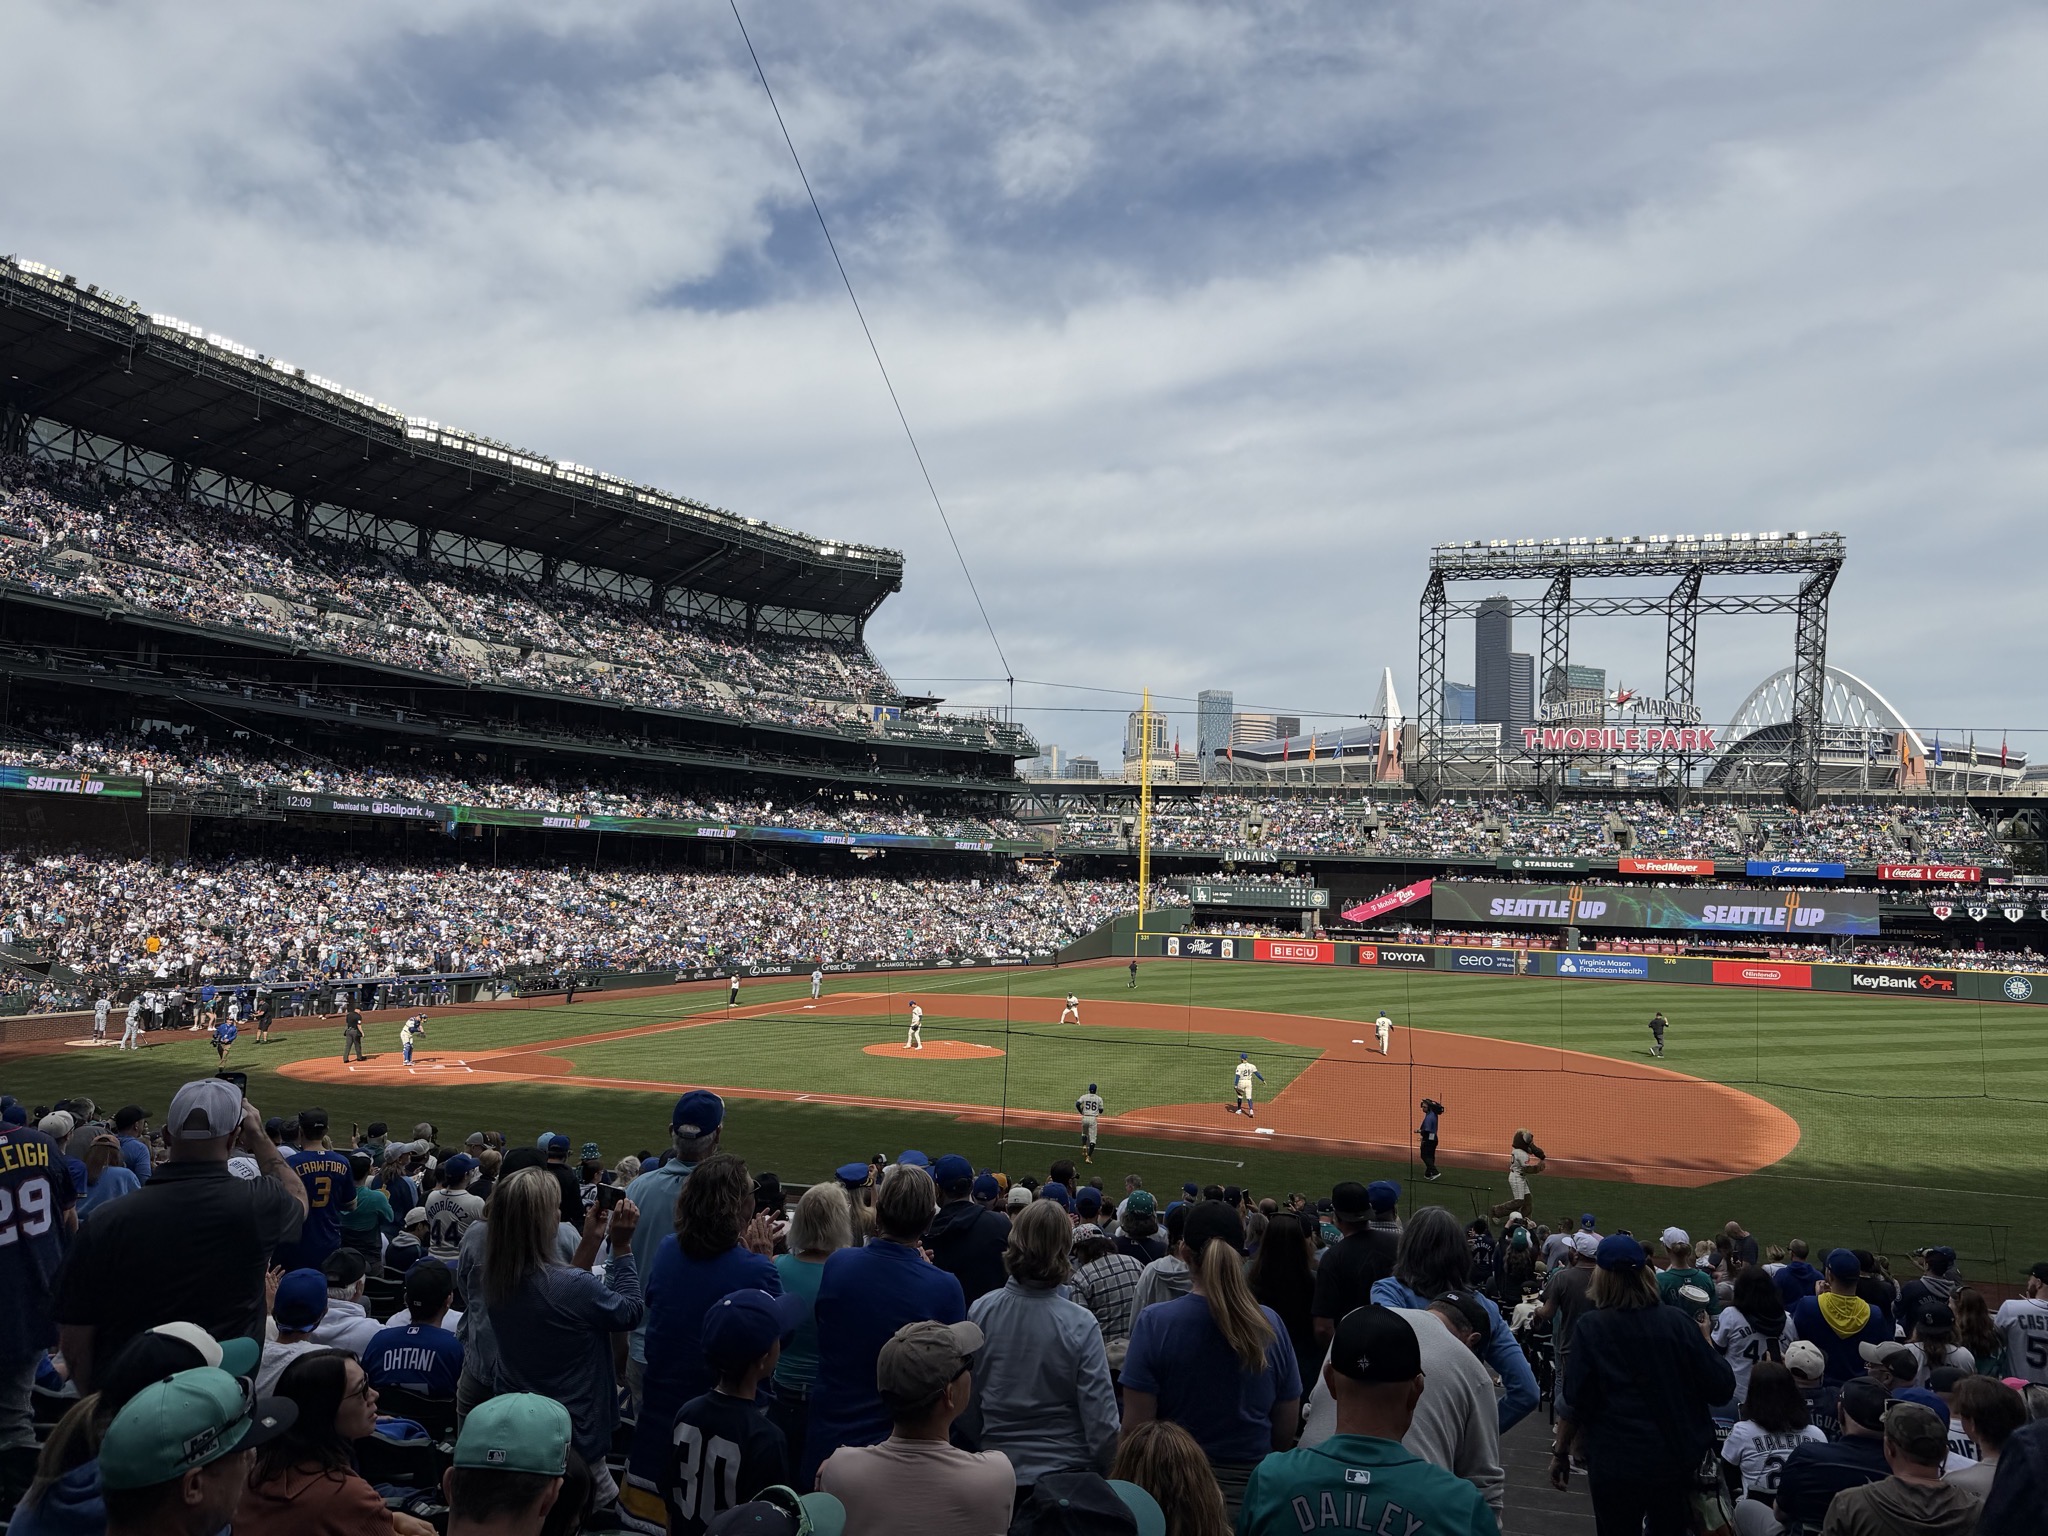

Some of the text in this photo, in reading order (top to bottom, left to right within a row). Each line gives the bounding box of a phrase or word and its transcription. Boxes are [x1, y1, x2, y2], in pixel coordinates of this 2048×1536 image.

[1539, 695, 1703, 723] SEATTLE MARINERS
[918, 723, 938, 731] Trident
[1521, 727, 1719, 751] T-MOBILE PARK
[26, 776, 104, 794] SEATTLE UP
[286, 795, 312, 808] 12:09
[333, 800, 436, 819] Download the Ballpark App
[542, 816, 590, 829] SEATTLE UP
[697, 827, 737, 839] SEATTLE UP
[823, 835, 856, 845] SEATTLE UP
[955, 841, 993, 851] SEATTLE UP
[1224, 850, 1277, 862] EDGARS
[1524, 860, 1575, 868] STARBUCKS
[1377, 897, 1397, 909] Mobile
[1490, 898, 1606, 919] SEATTLE UP
[1702, 903, 1825, 927] SEATTLE UP
[1935, 907, 1949, 917] 42
[1972, 908, 1984, 917] 24
[2009, 910, 2018, 919] 11
[1381, 951, 1426, 963] TOYOTA
[1459, 955, 1493, 967] eero
[760, 966, 791, 974] LEXUS
[821, 962, 857, 972] Great Clips
[1578, 959, 1631, 969] Virginia Mason
[1579, 966, 1643, 975] Franciscan Health
[1745, 971, 1778, 979] Nintendo
[1853, 974, 1917, 990] KeyBank
[1085, 1100, 1098, 1111] 56
[296, 1160, 349, 1176] CRAWFORD
[311, 1176, 332, 1208] 3
[430, 1219, 463, 1247] 44
[1473, 1251, 1490, 1264] 44
[2026, 1335, 2048, 1369] 5
[383, 1348, 437, 1373] OHTANI
[671, 1422, 742, 1527] 30
[1764, 1456, 1785, 1489] 2
[1290, 1490, 1425, 1536] DAILEY
